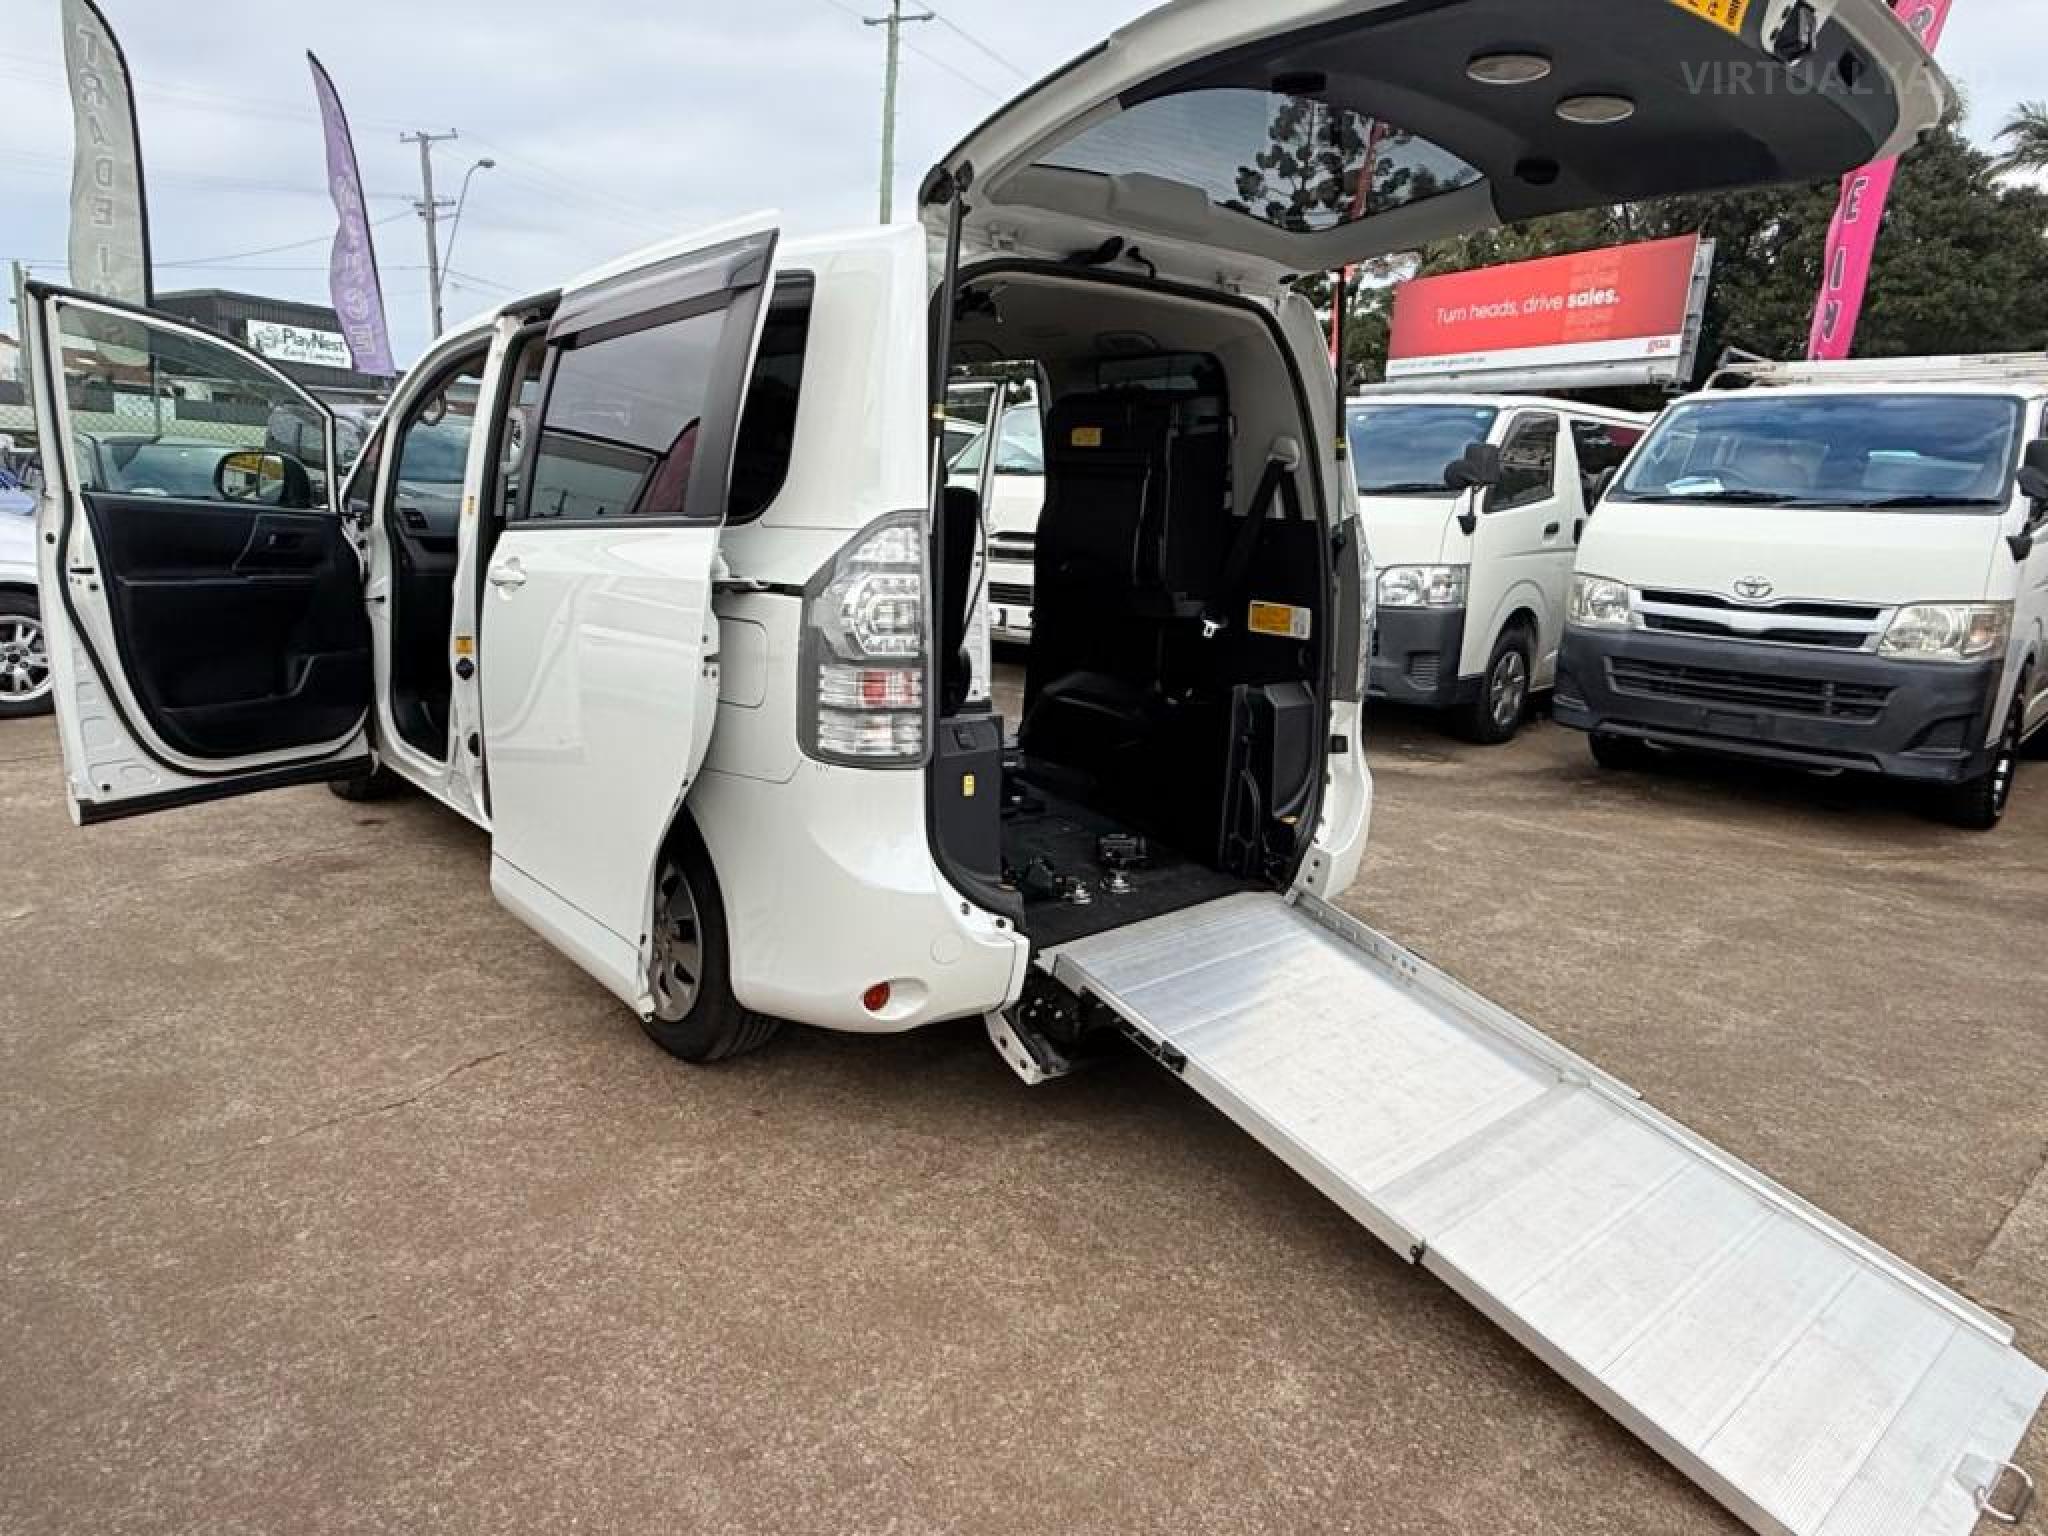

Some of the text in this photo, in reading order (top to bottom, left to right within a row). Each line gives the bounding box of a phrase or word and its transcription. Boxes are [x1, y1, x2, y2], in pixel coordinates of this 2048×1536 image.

[1438, 305, 1466, 327] Turn
[1523, 293, 1565, 313] drive
[1568, 287, 1621, 309] sales.
